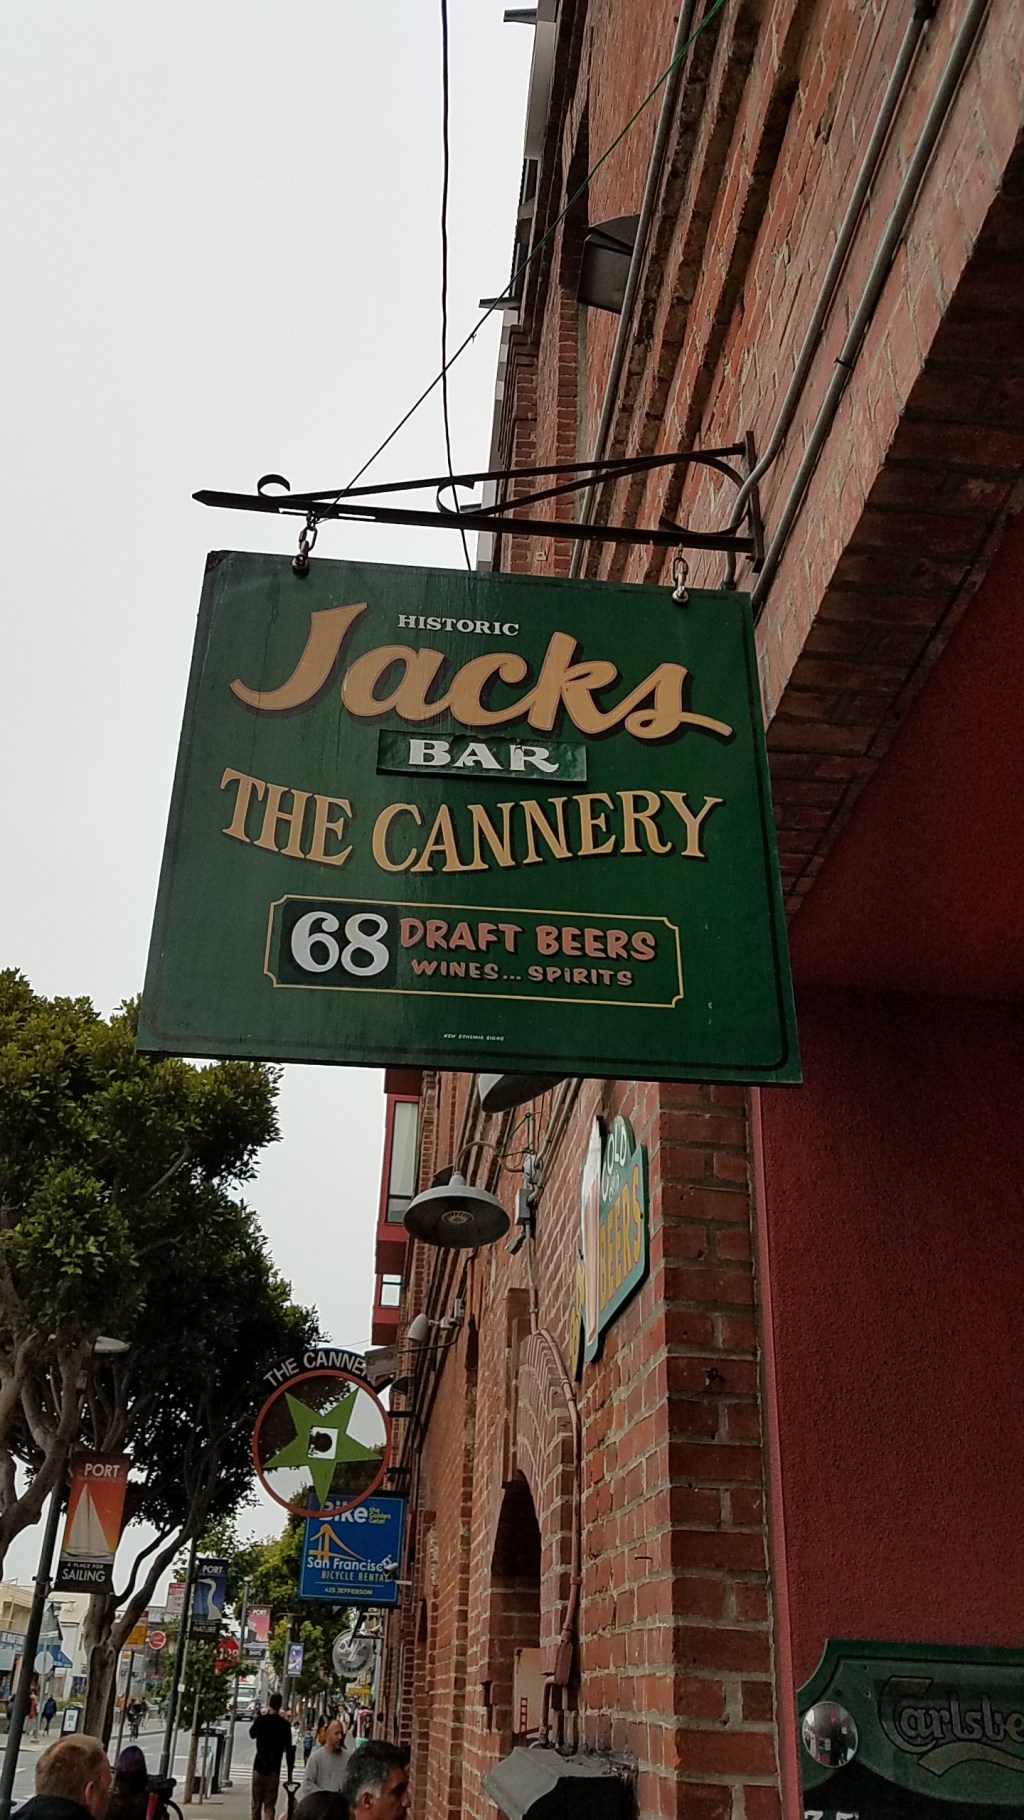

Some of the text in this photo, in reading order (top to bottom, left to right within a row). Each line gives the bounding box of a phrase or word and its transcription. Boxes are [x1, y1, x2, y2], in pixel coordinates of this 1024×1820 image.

[398, 614, 519, 636] HISTORIC
[229, 602, 734, 739] Jacks
[408, 739, 560, 773] BAR
[220, 767, 723, 873] THE CANNERY
[290, 910, 656, 977] 68 DRAFT BEERS
[528, 967, 634, 987] SPIRITS
[601, 1123, 627, 1202] COLD
[599, 1163, 641, 1312] BEERS
[263, 1350, 367, 1387] THE CANNE
[84, 1463, 120, 1477] PORT
[61, 1568, 106, 1582] SAILING
[202, 1564, 224, 1574] PORT
[307, 1556, 330, 1569] San
[321, 1570, 354, 1580] BICYCLE
